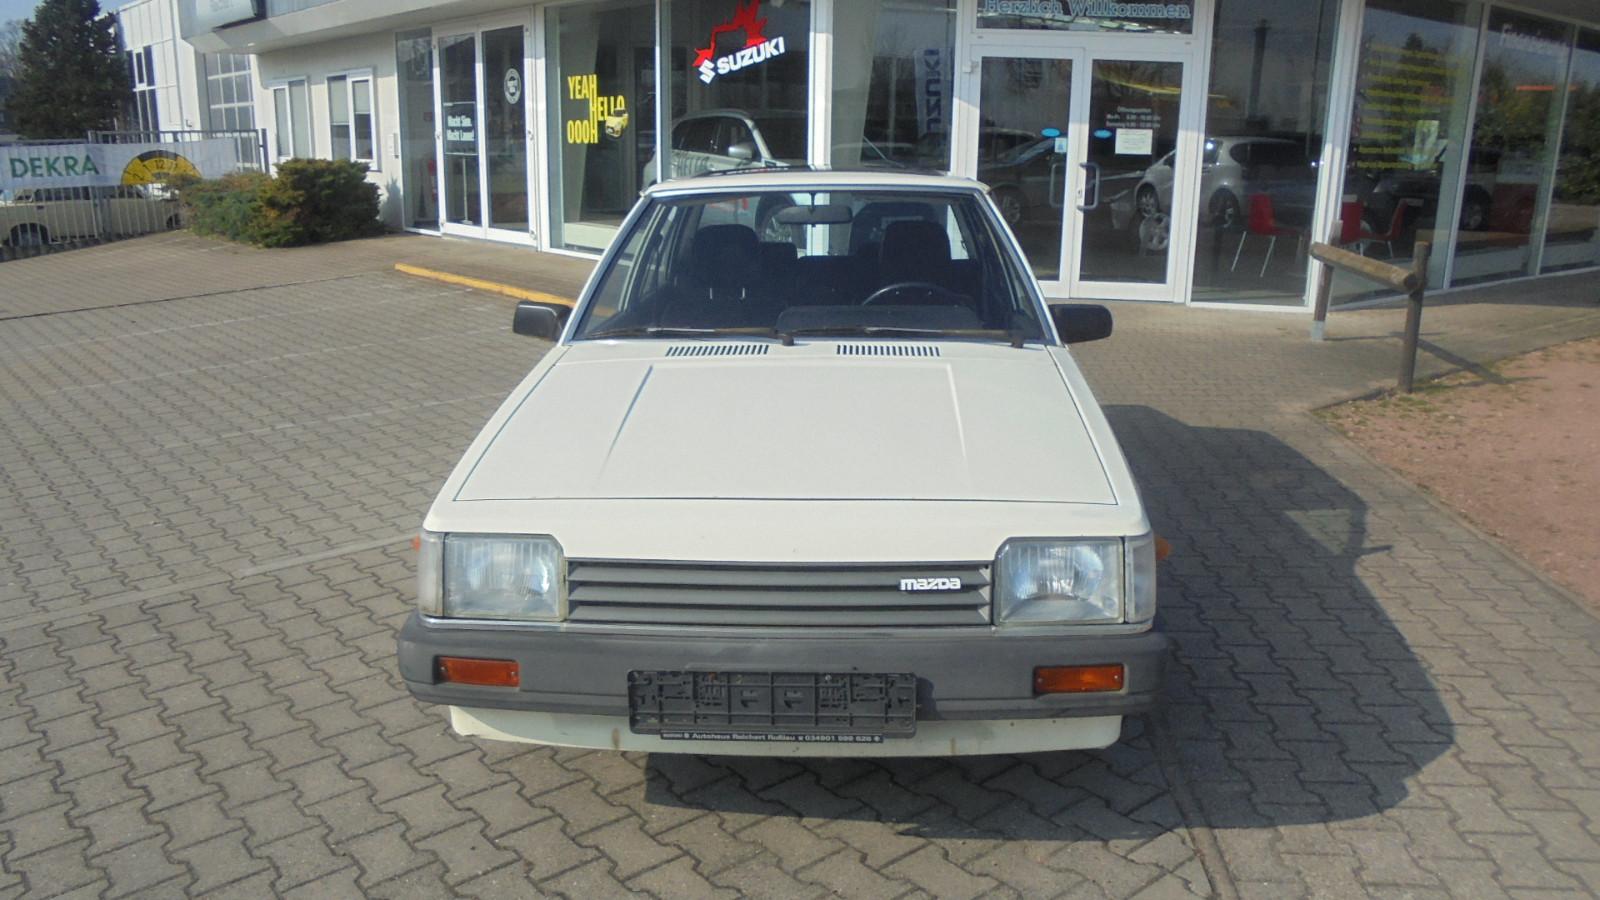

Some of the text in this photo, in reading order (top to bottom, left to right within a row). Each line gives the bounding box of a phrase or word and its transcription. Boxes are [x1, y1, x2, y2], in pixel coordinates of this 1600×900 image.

[984, 0, 1191, 18] Herzlich Willkommen
[717, 36, 785, 75] SUZUKI
[568, 74, 597, 100] YEAH
[567, 120, 598, 144] OOOH
[10, 155, 99, 178] DEKRA
[900, 578, 961, 591] mazda
